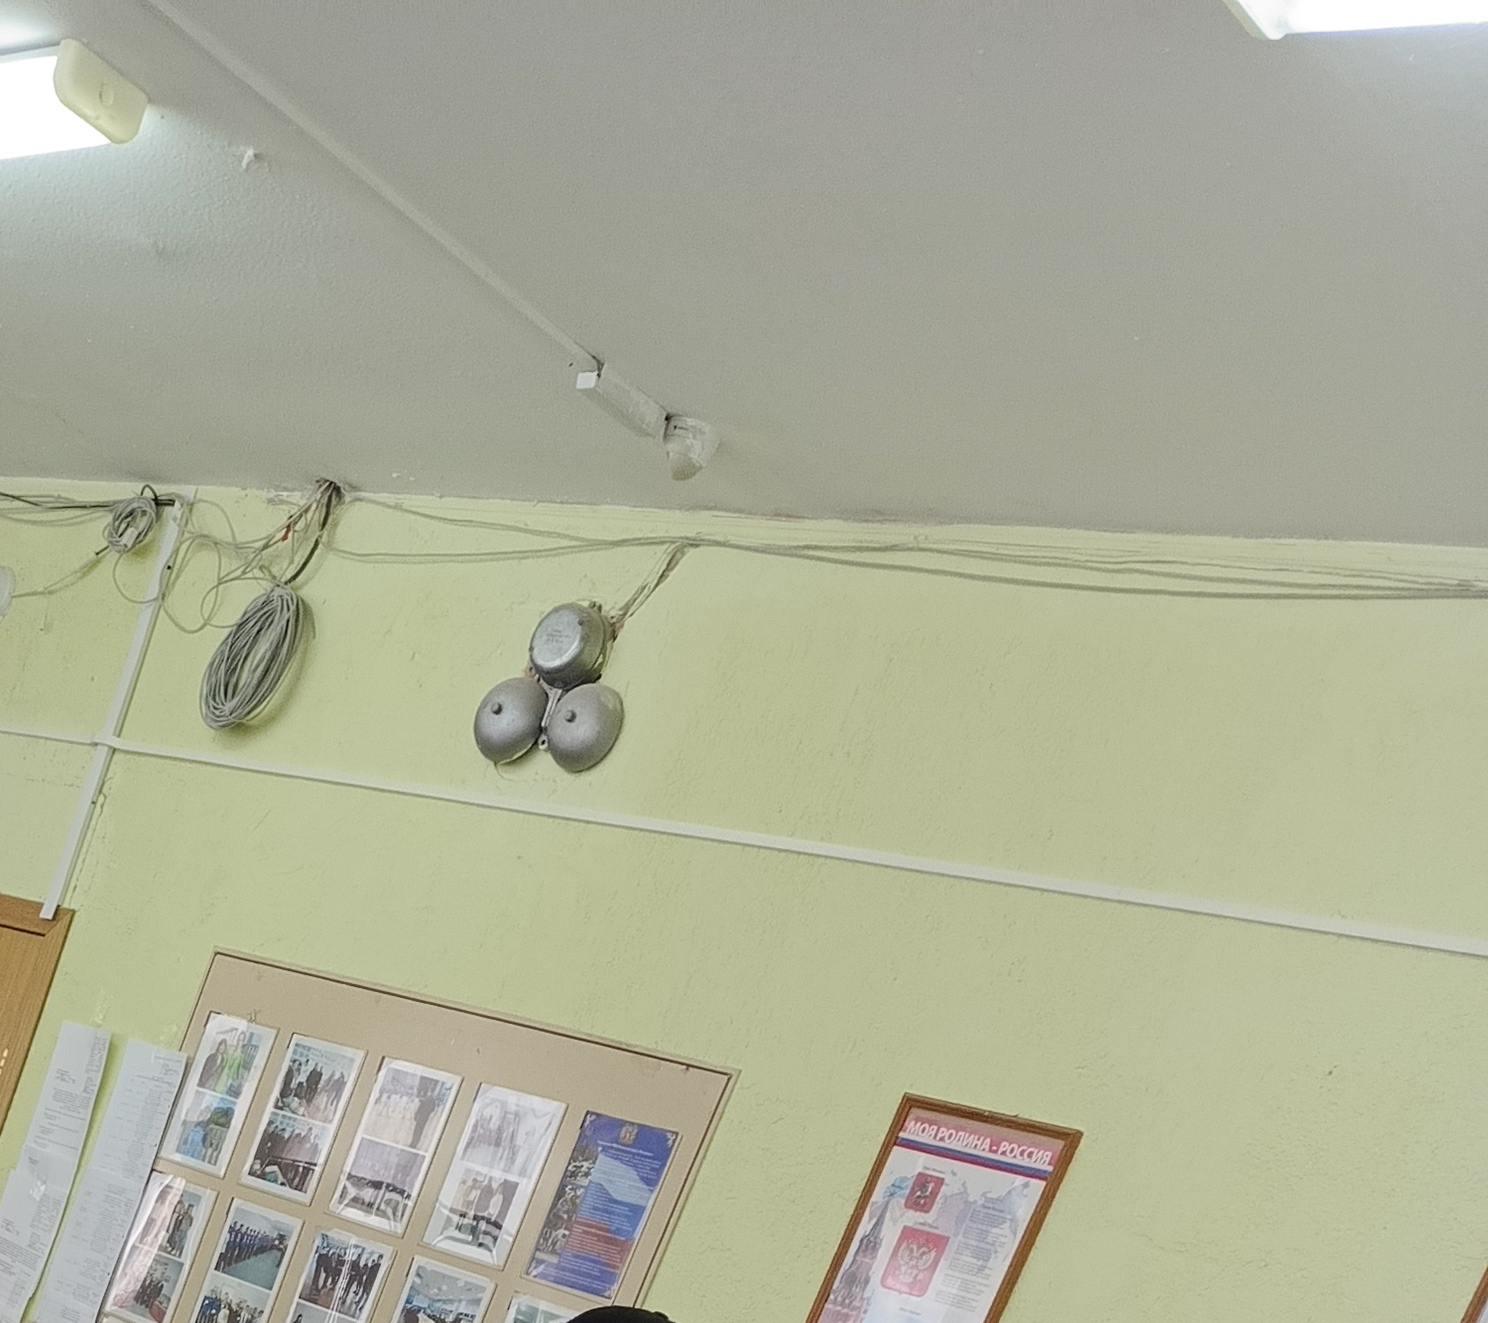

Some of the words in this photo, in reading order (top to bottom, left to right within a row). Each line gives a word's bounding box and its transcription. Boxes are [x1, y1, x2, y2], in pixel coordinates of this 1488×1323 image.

[906, 1120, 937, 1141] МОЯ
[935, 1127, 992, 1152] РОДИНА
[998, 1141, 1053, 1167] РОССИЯ
